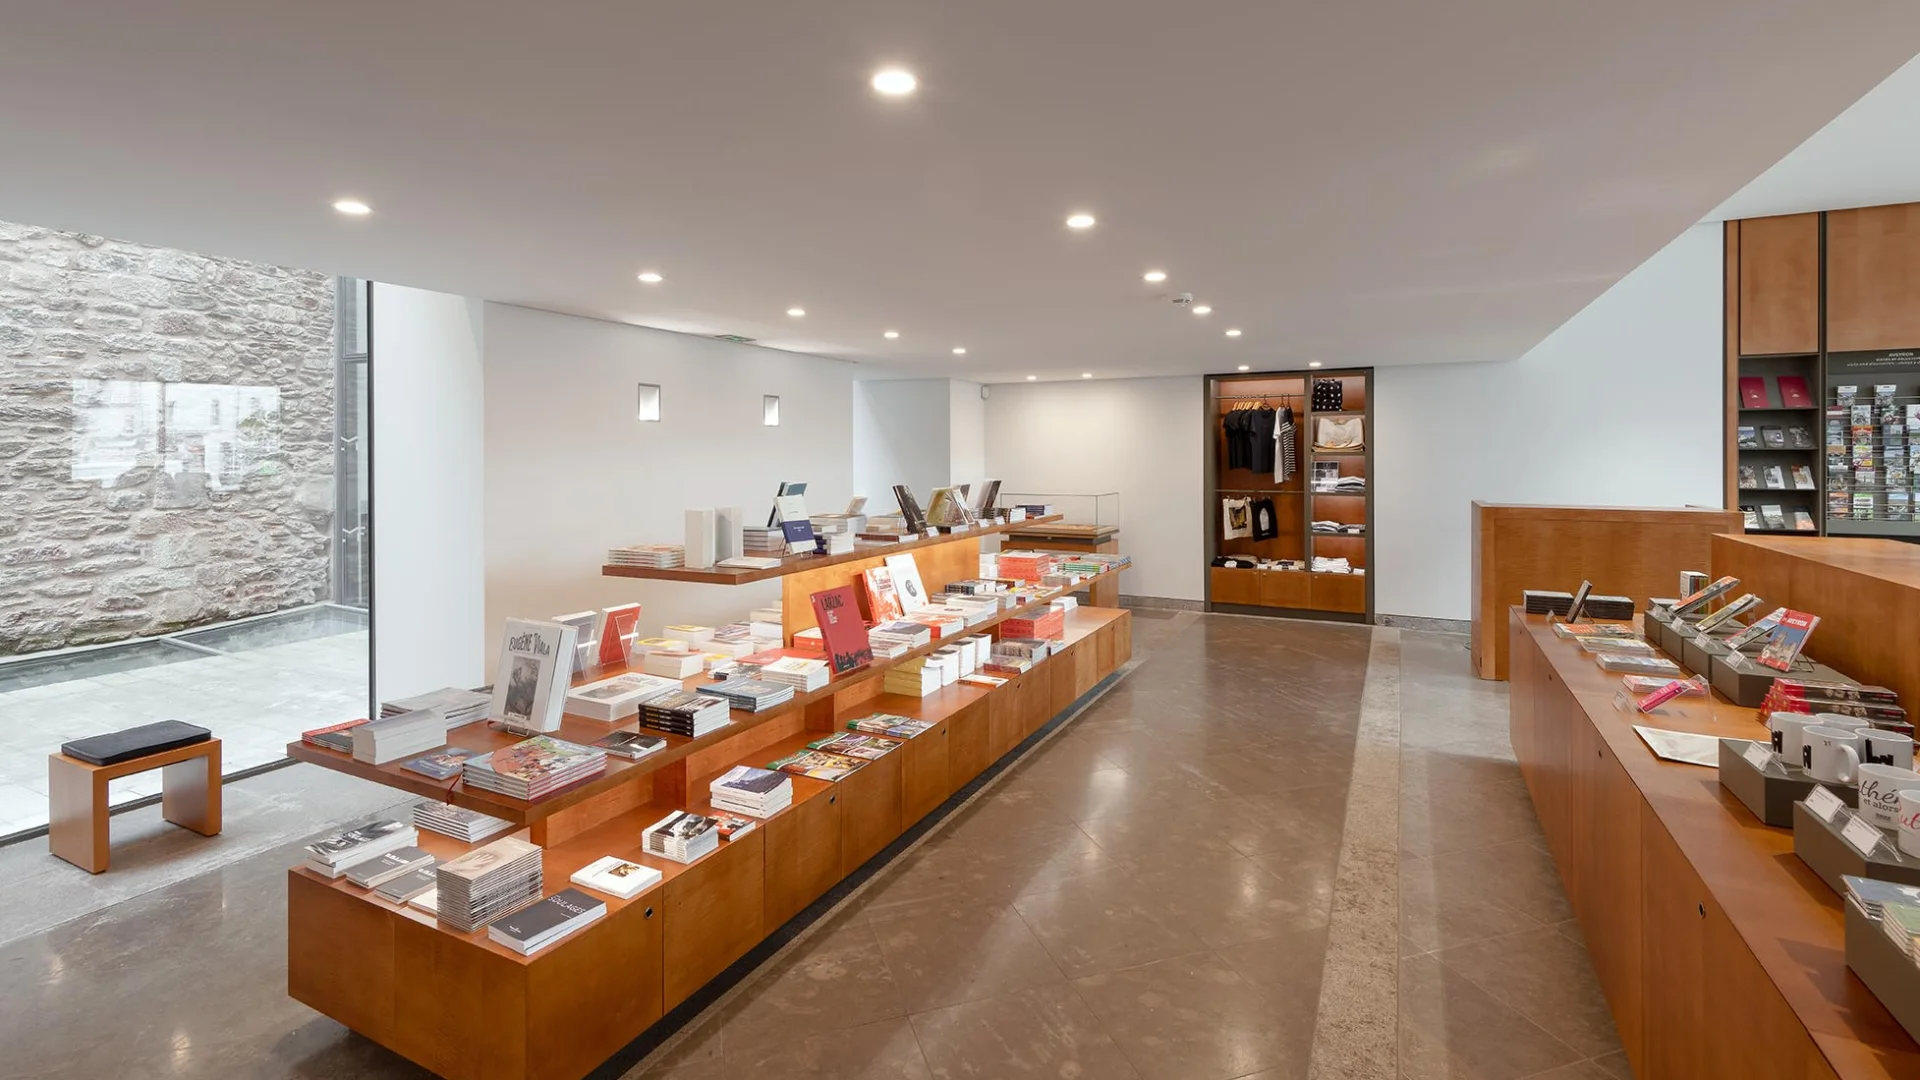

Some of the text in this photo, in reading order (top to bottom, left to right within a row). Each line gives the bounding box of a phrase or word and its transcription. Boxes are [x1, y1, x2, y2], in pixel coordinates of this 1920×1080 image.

[821, 594, 844, 611] LARZAC
[509, 632, 550, 656] EUGÈNE VIALA
[1873, 801, 1899, 813] alors
[548, 894, 586, 914] SOULAGES
